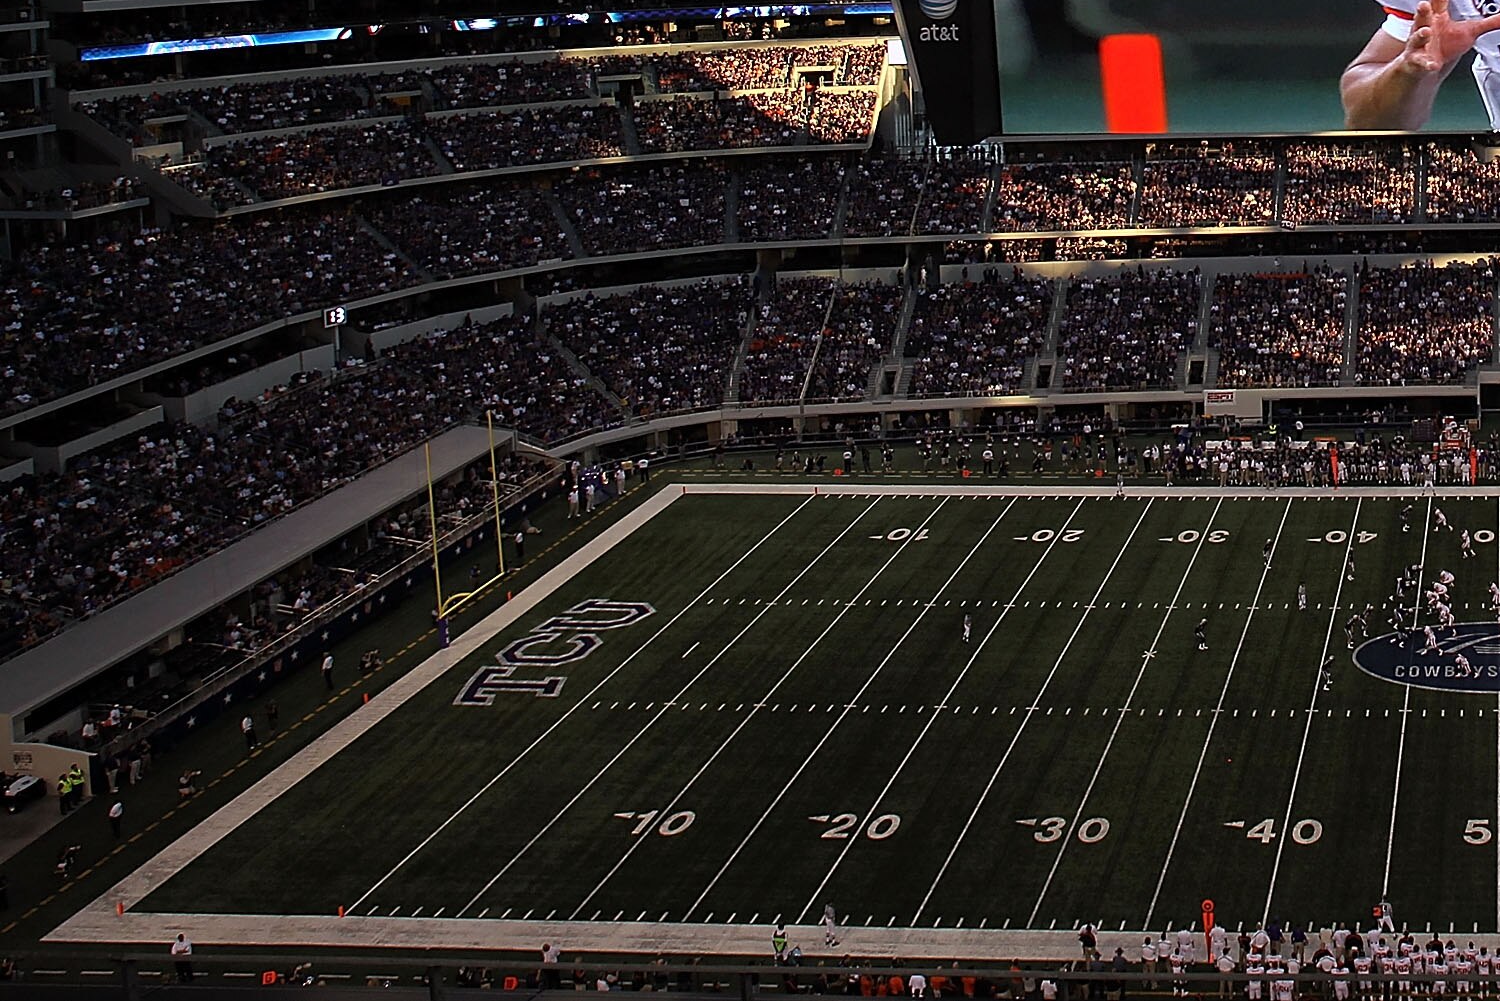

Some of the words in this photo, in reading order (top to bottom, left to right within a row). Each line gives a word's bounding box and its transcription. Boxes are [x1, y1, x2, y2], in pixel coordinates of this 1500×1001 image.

[919, 23, 960, 41] at&t
[452, 598, 657, 706] TCU
[1393, 663, 1498, 679] COWBYS
[629, 809, 696, 836] 10
[820, 813, 901, 840] 20
[1033, 816, 1110, 843] 30
[1246, 818, 1323, 845] 40
